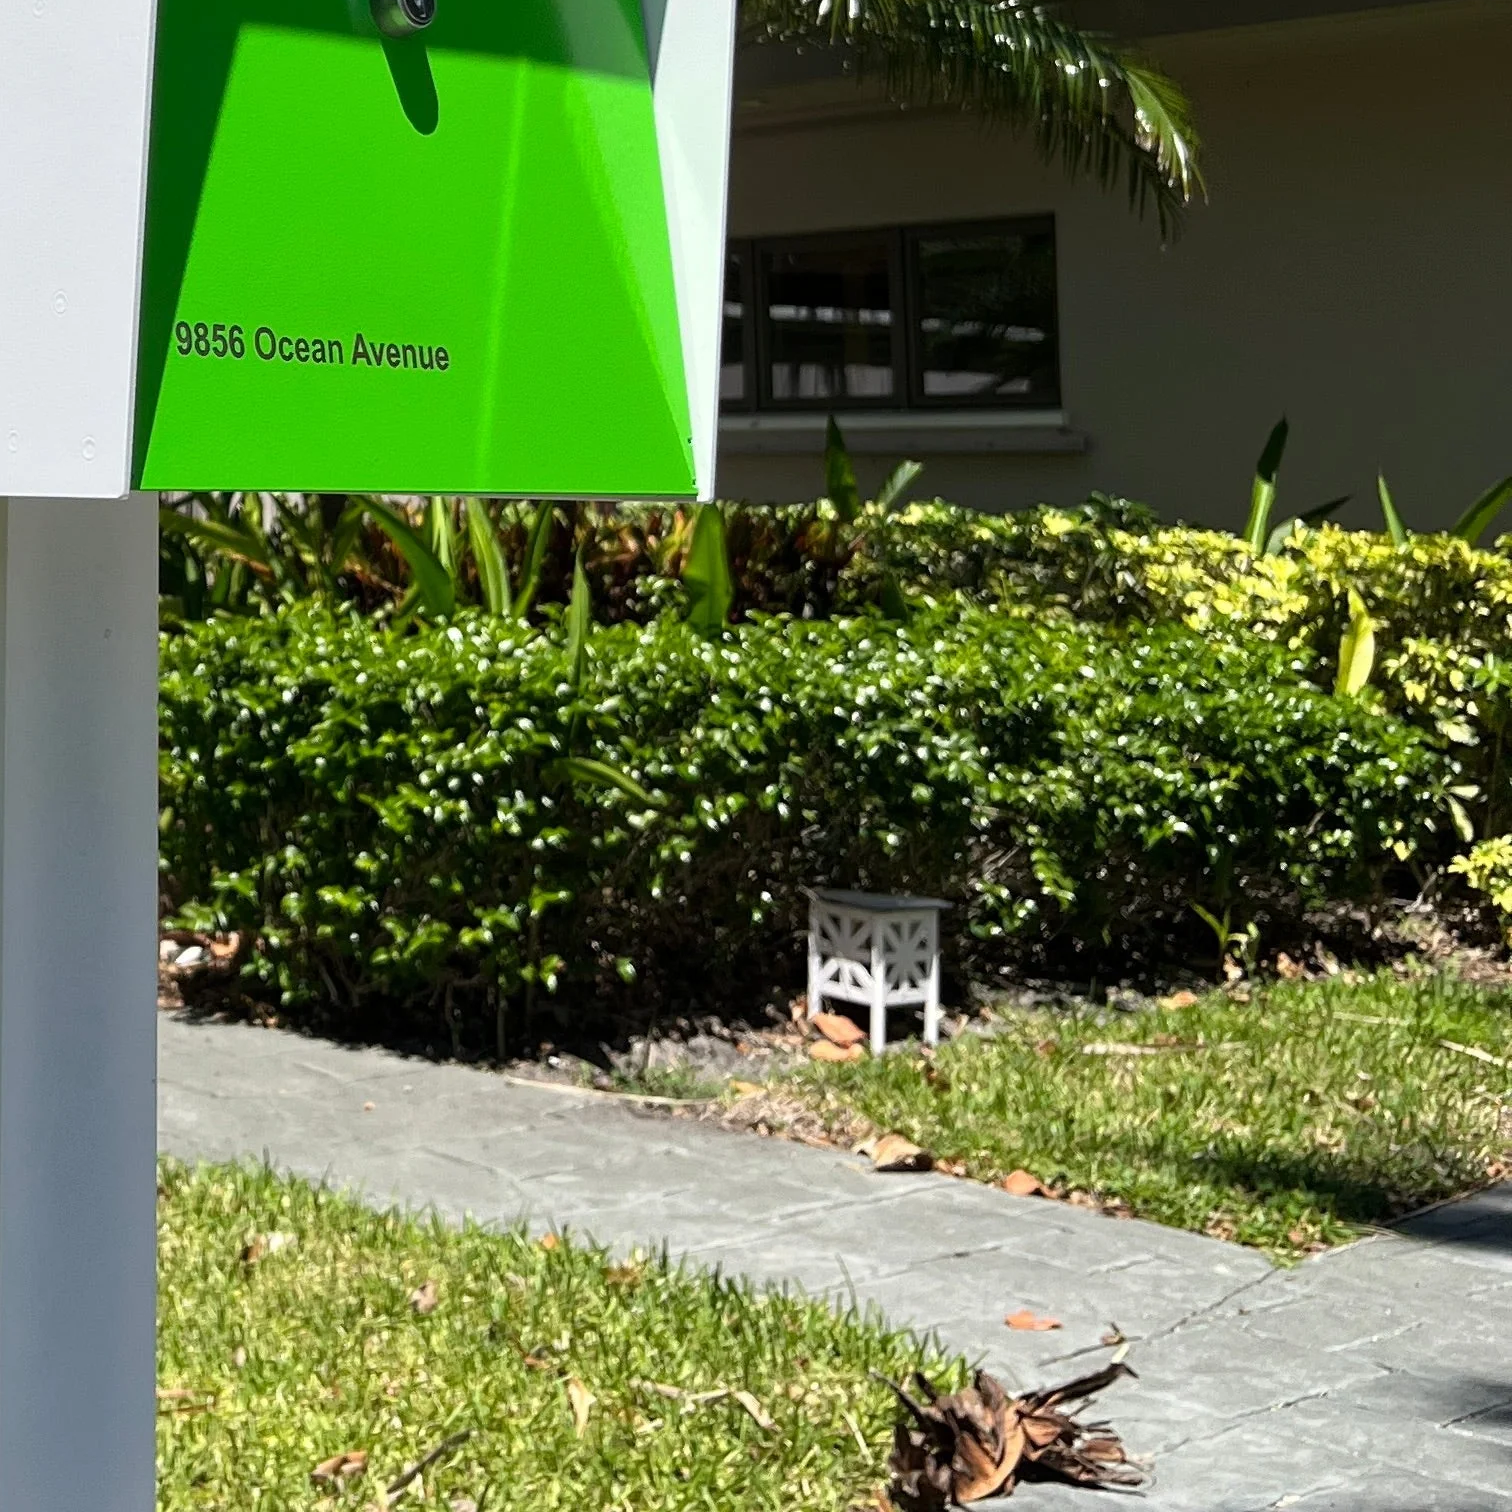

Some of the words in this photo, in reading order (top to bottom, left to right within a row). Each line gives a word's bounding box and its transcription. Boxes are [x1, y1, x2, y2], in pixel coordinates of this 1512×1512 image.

[175, 321, 244, 358] 9856
[255, 327, 343, 364] Ocean
[352, 333, 449, 370] Avenue
